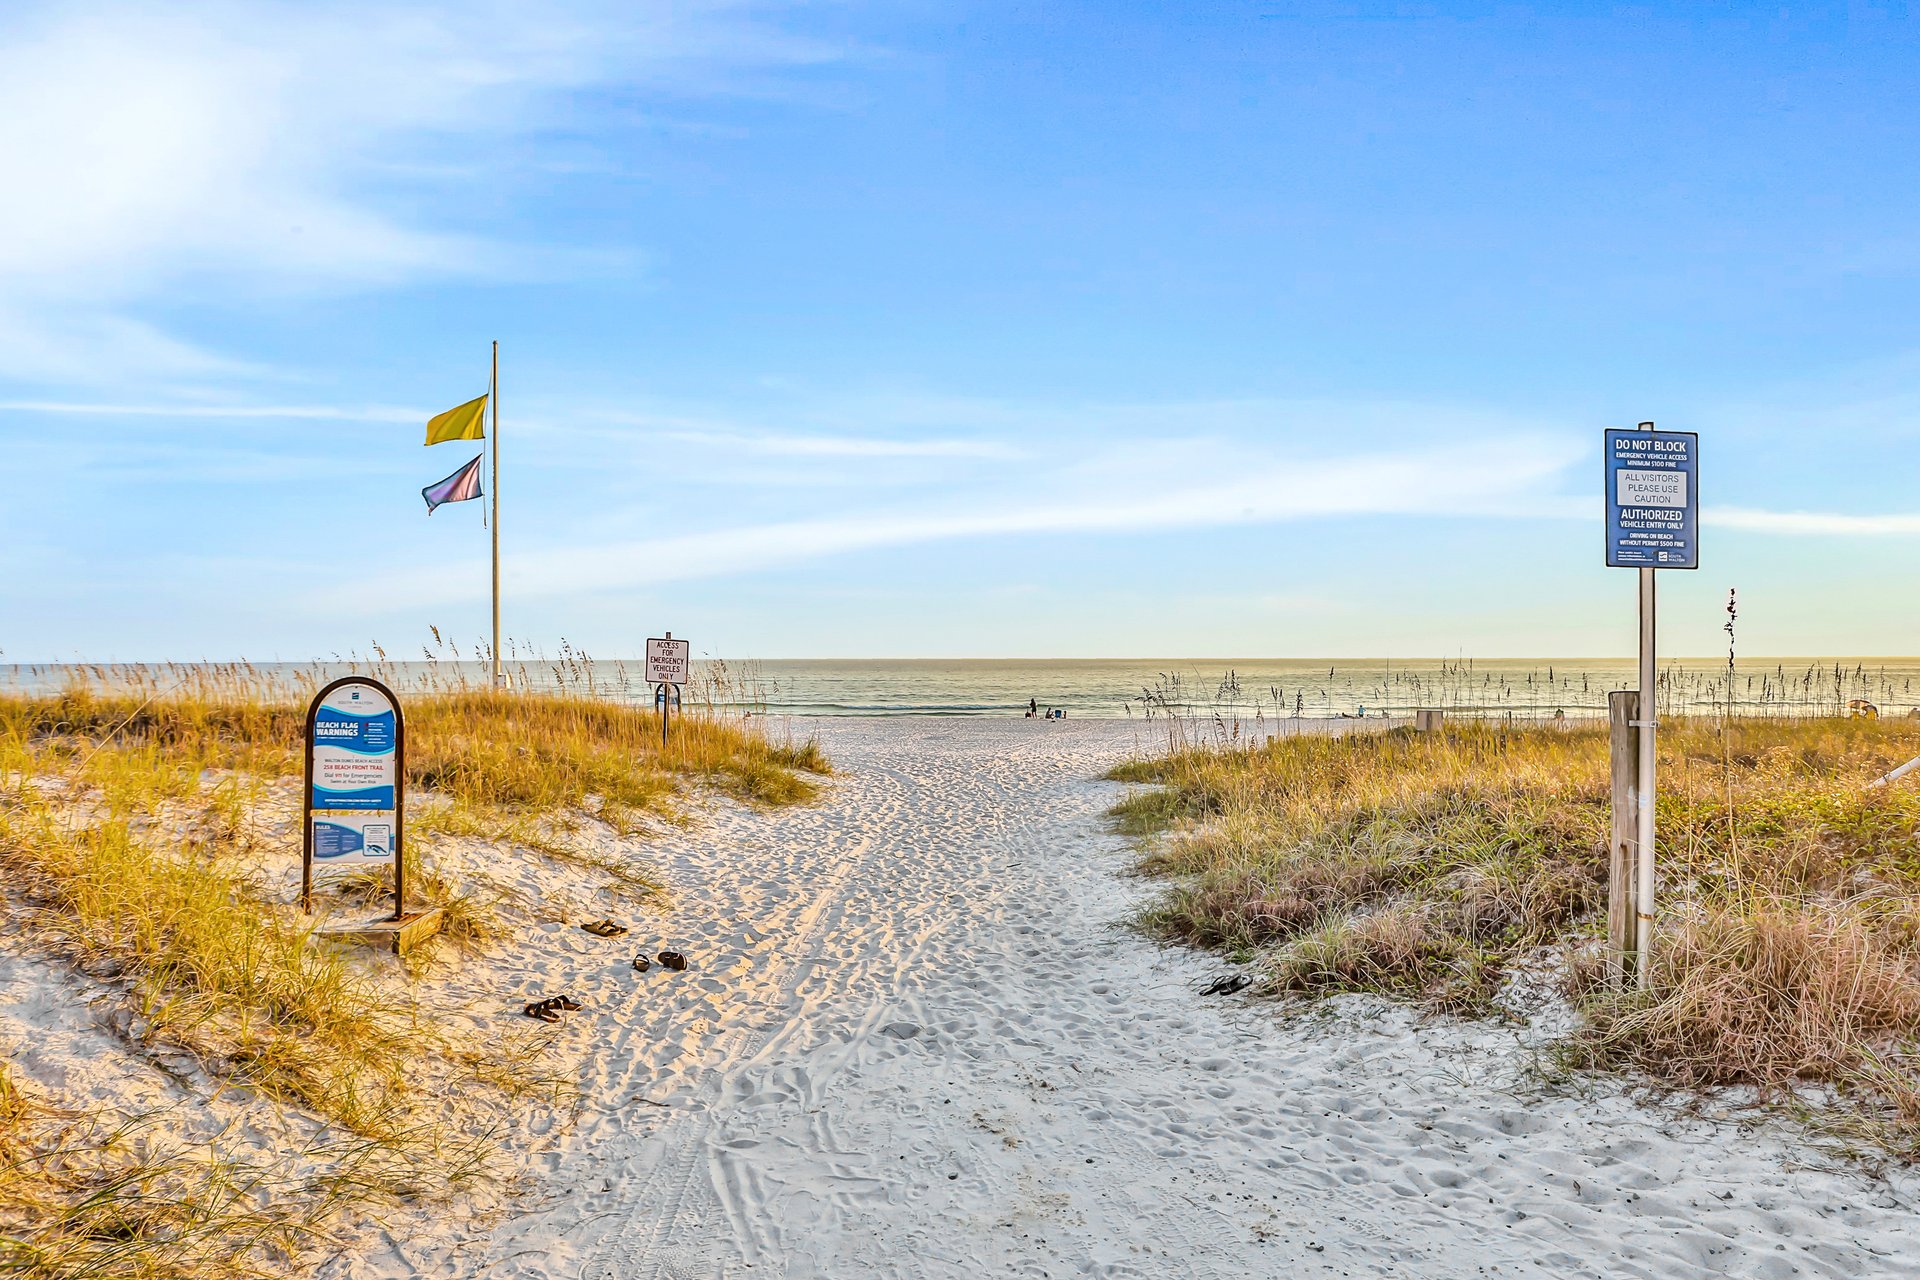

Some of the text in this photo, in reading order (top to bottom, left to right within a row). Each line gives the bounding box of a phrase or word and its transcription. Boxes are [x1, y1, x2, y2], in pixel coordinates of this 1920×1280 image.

[1616, 440, 1686, 452] DO NOT BLOCK
[1625, 473, 1679, 482] ALL VISITORS
[1628, 484, 1659, 492] PLEASE
[1635, 495, 1670, 503] CAUTION
[1621, 509, 1682, 520] AUTHORIZED
[650, 656, 684, 665] EMERGENCY
